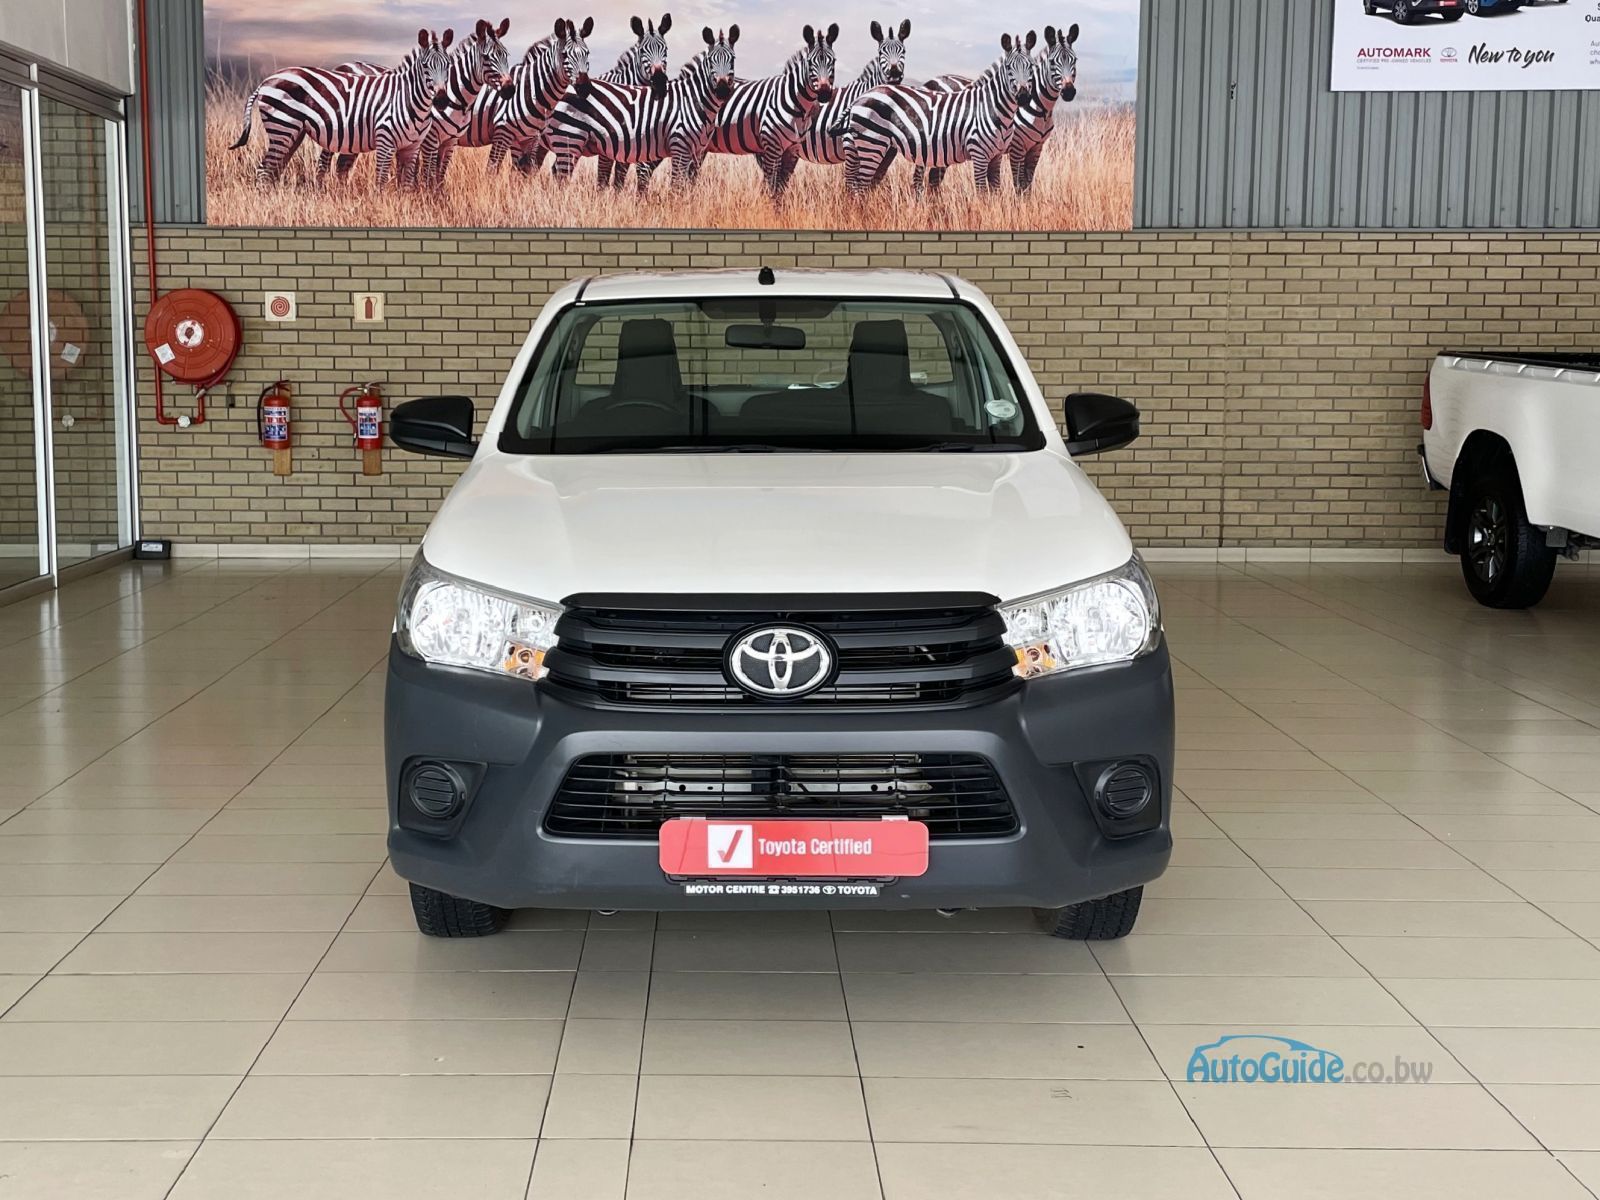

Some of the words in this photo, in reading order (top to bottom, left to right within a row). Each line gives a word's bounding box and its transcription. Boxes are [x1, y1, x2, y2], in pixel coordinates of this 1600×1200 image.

[1357, 47, 1431, 58] AUTOMARK
[1468, 42, 1505, 65] New
[1506, 46, 1523, 63] to
[1521, 49, 1555, 69] you
[757, 838, 807, 857] Toyota
[810, 838, 872, 855] Certified
[685, 885, 724, 894] MOTOR
[725, 885, 766, 894] CENTRE
[780, 885, 821, 895] 3951736
[837, 885, 877, 895] TOYOTA
